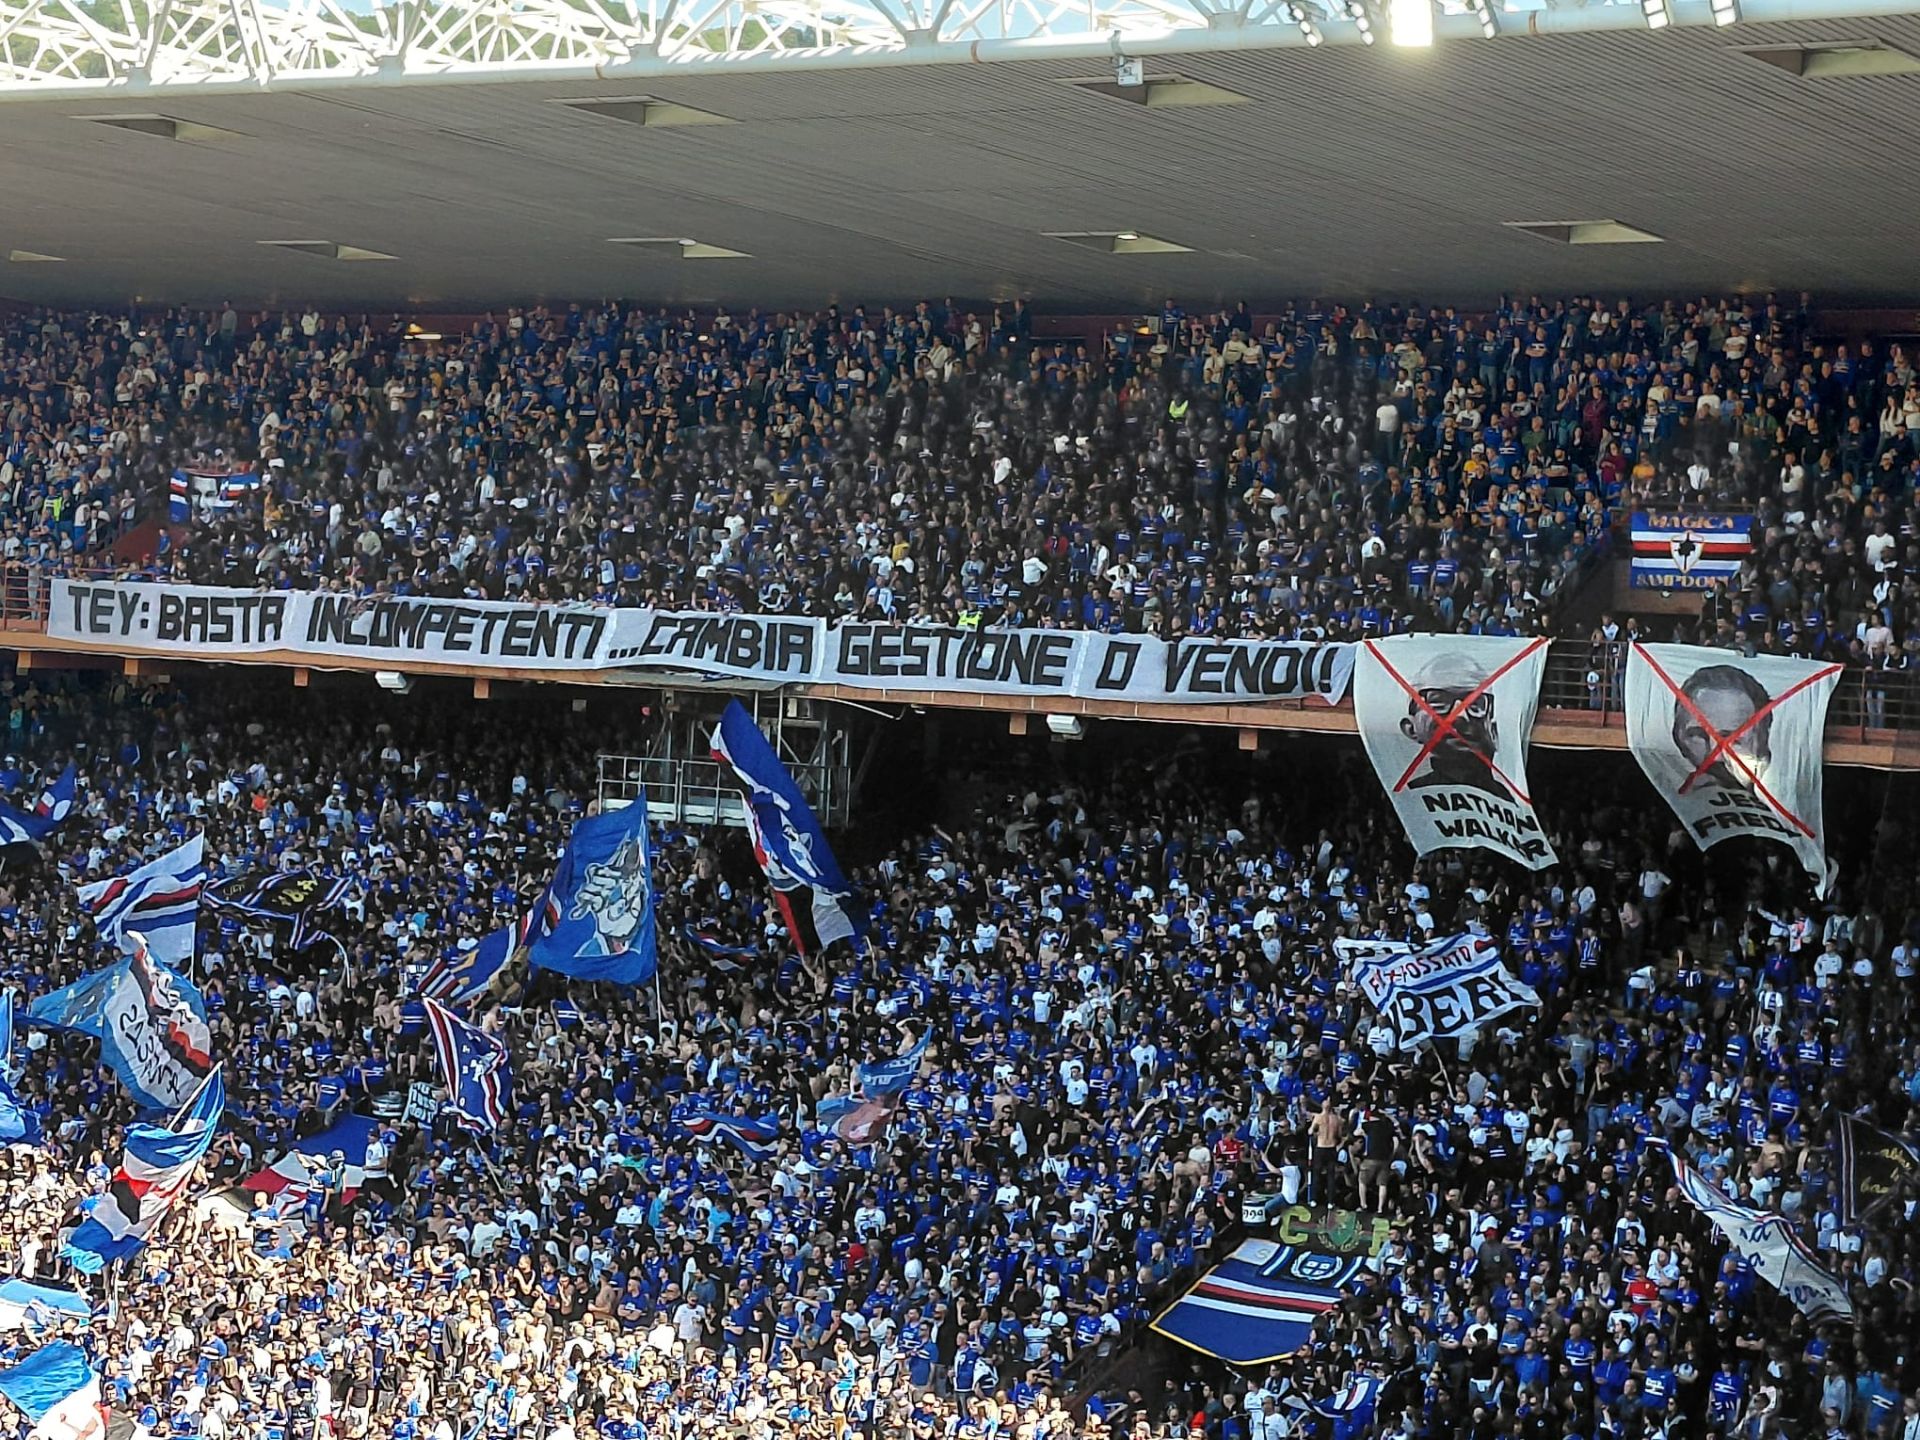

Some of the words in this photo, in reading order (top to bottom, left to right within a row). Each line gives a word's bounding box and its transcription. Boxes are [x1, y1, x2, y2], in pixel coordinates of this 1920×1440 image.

[1648, 515, 1735, 529] MAGICA
[68, 586, 149, 635] TEY:
[156, 593, 287, 643] BASTA
[306, 594, 607, 661] INCOMPETENTI
[836, 625, 1073, 686] GESTIONE
[1421, 792, 1539, 835] NATHAN
